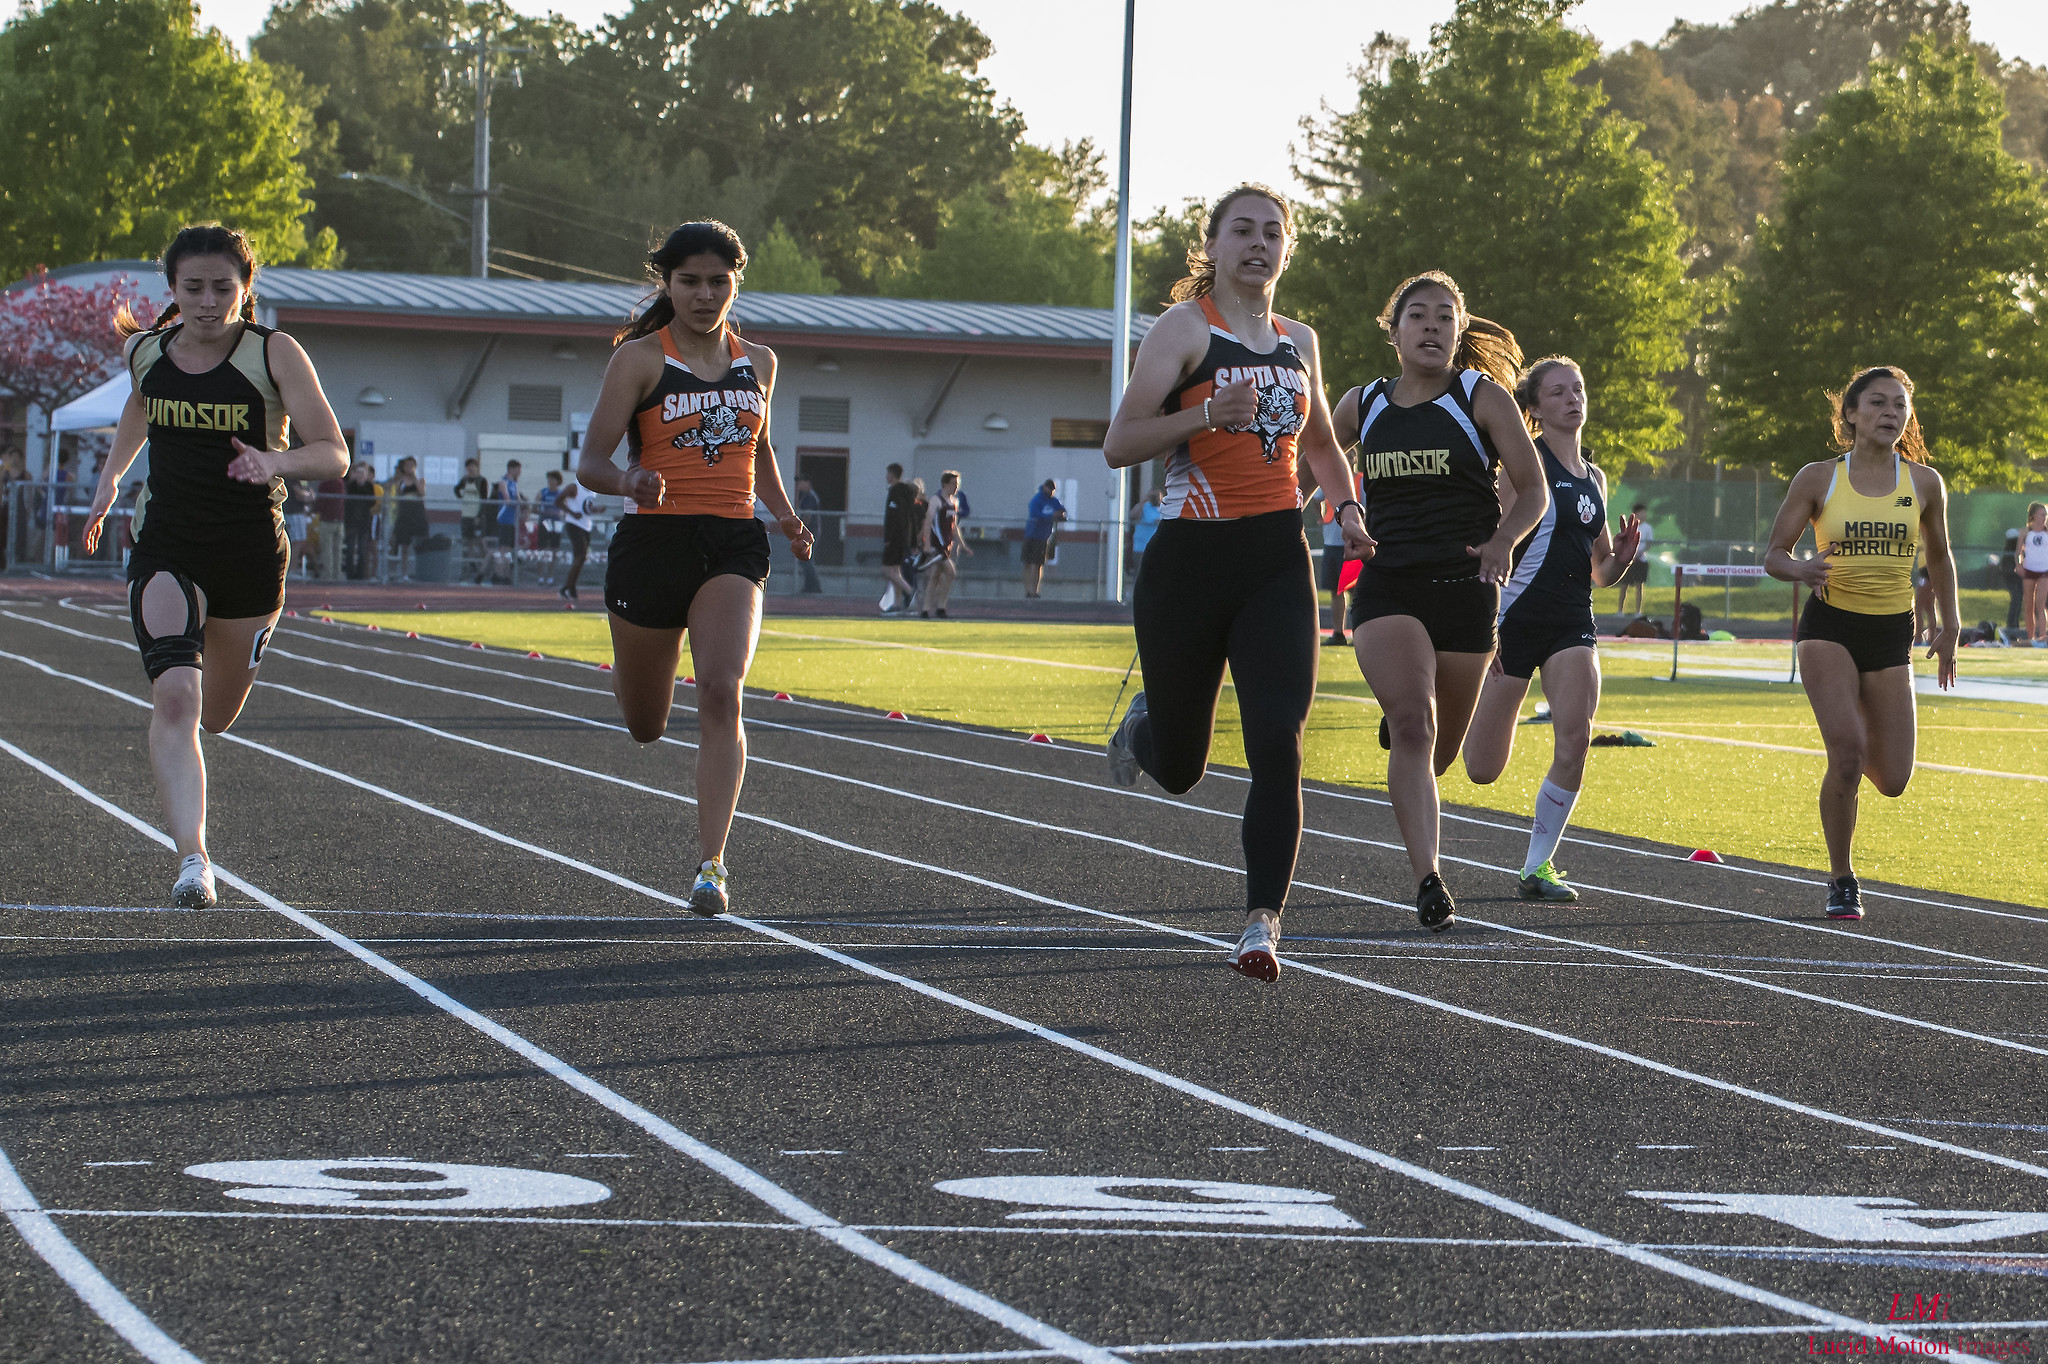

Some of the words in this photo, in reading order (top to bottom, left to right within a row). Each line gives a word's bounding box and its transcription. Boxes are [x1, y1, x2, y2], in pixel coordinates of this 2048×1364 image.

[662, 390, 722, 422] SANTA
[1365, 449, 1450, 480] WINDSOR
[1844, 521, 1908, 540] MARIA
